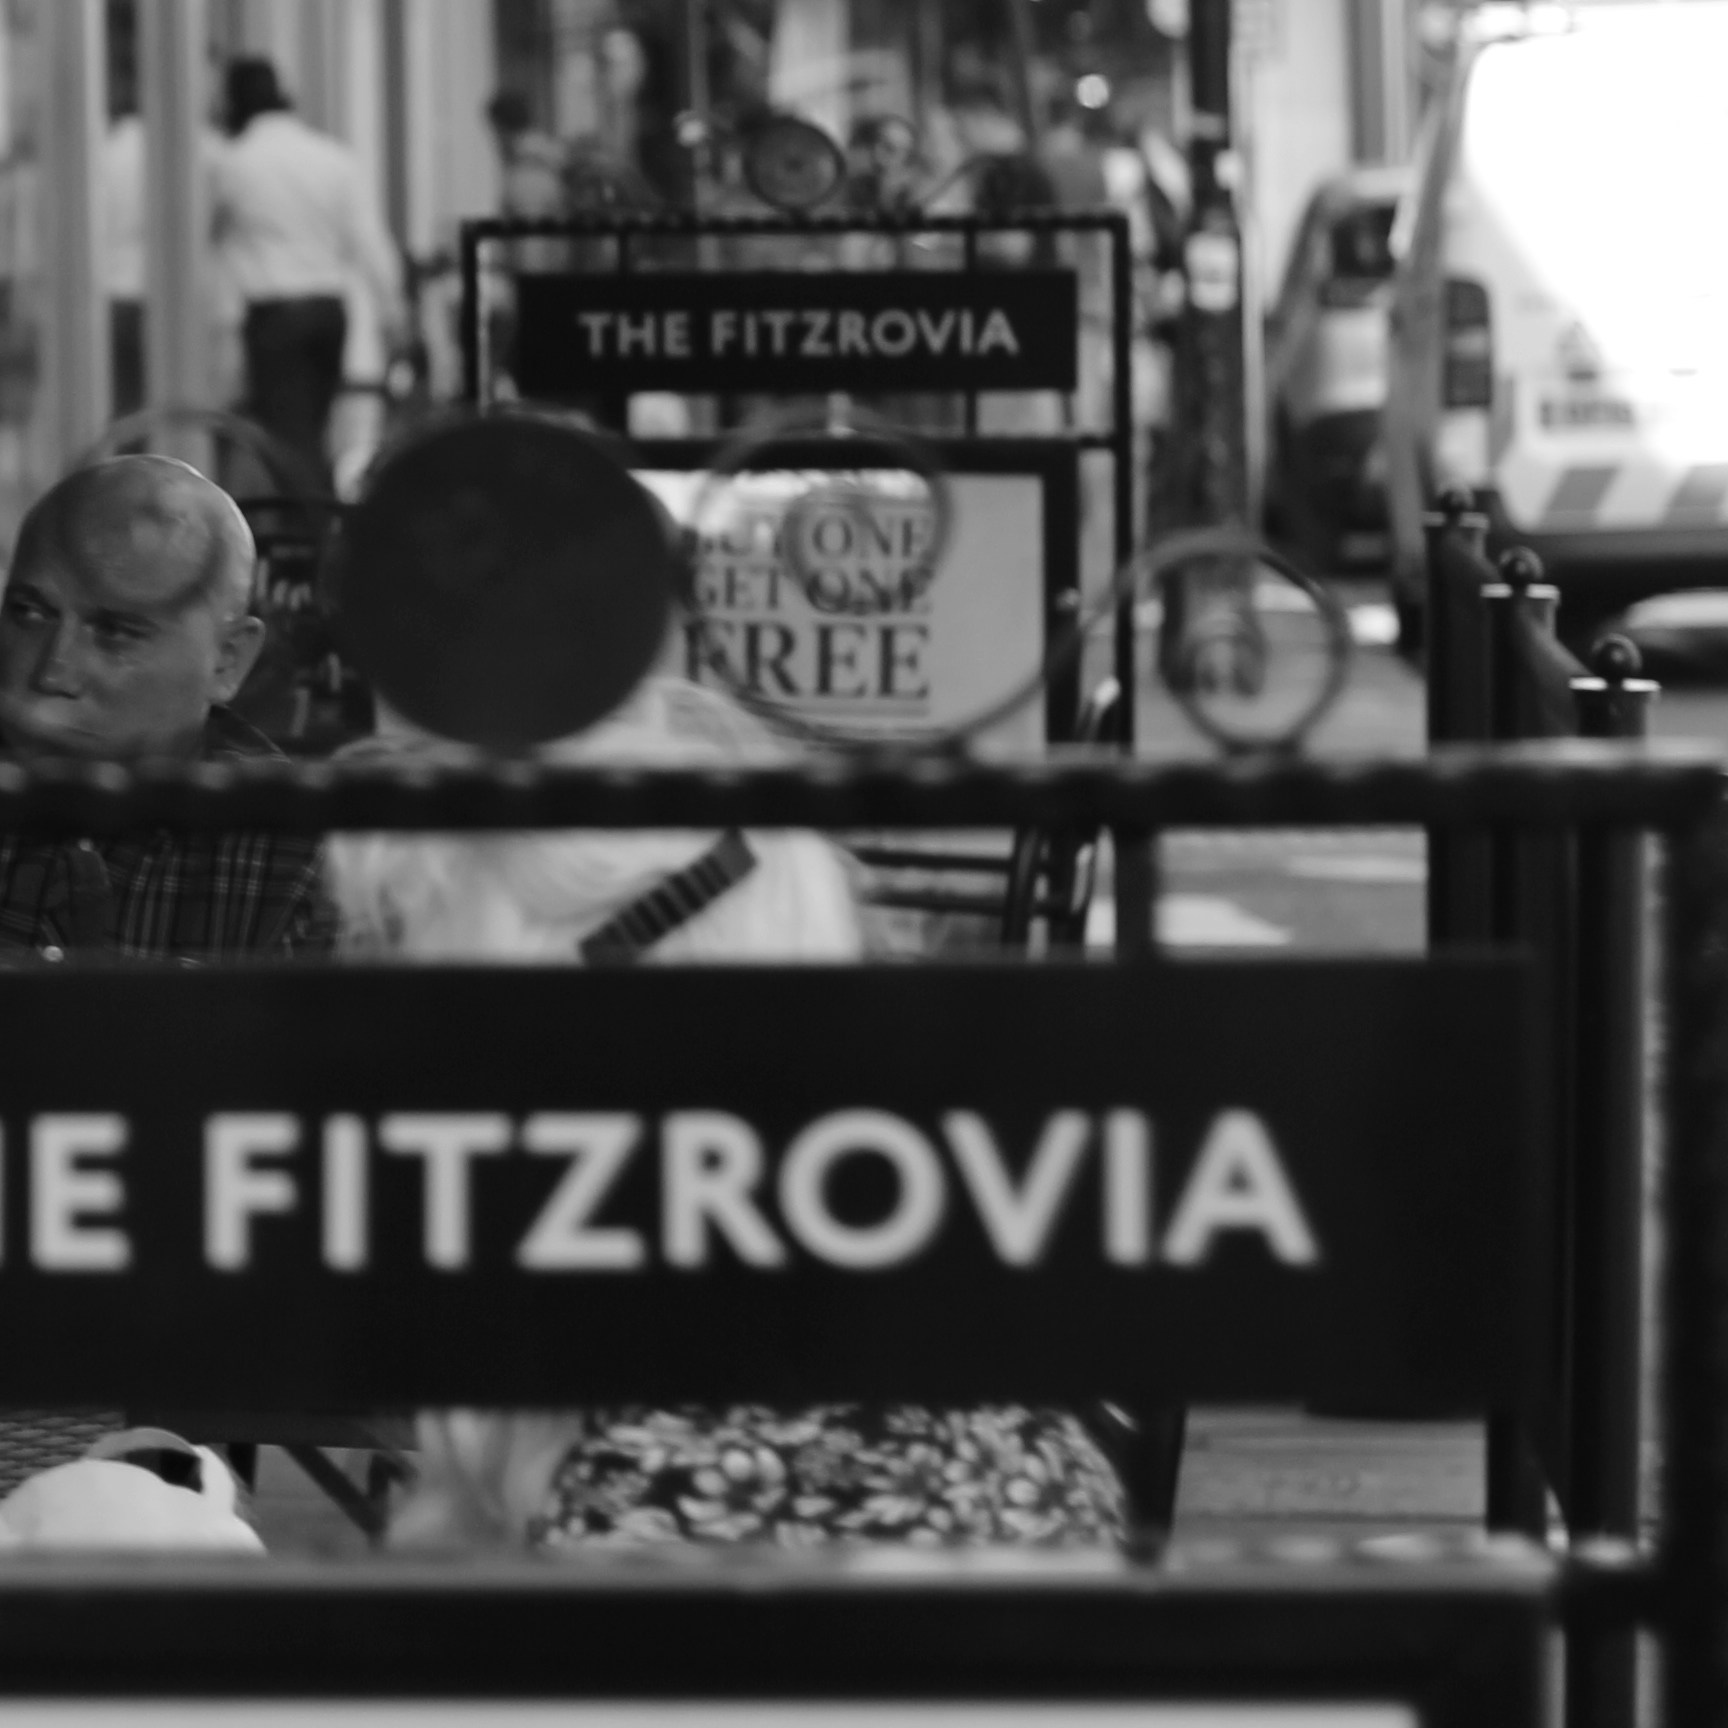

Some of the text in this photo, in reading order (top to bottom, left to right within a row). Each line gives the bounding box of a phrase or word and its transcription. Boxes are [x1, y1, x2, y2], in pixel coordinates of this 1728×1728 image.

[579, 309, 1019, 359] THE FITZROVIA
[684, 621, 932, 700] FREE
[204, 1108, 1320, 1271] FITZROVIA
